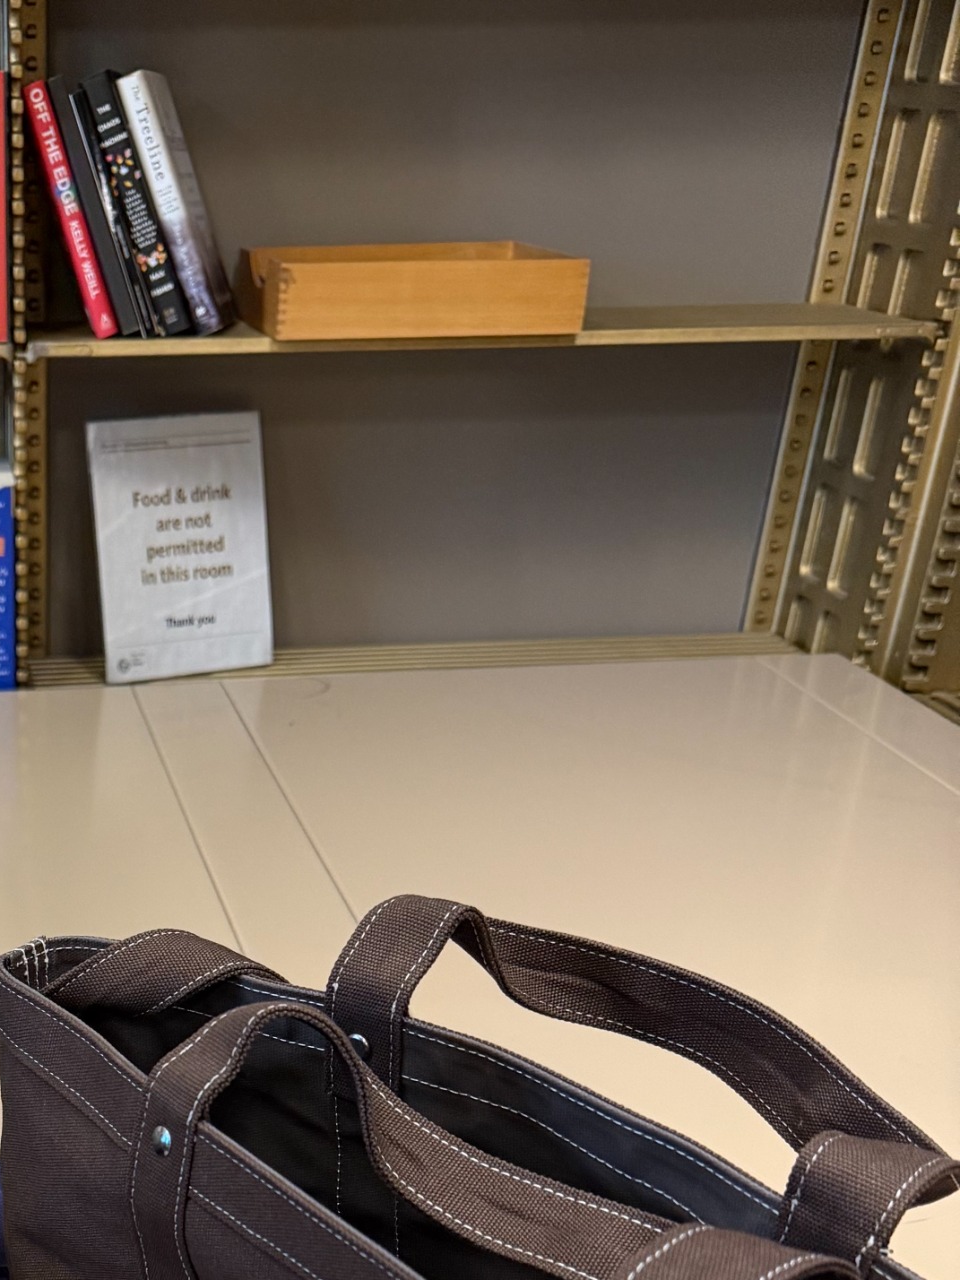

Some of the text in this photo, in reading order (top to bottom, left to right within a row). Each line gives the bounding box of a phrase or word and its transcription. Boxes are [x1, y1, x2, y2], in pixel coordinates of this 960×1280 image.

[130, 84, 142, 102] The
[96, 103, 112, 116] THE
[29, 86, 80, 217] OFF THE EDGE
[135, 102, 166, 183] Treeline
[69, 220, 101, 301] KELLY WEILL
[131, 483, 233, 508] Food & drink
[155, 512, 213, 532] are not
[146, 536, 226, 563] permitted
[141, 564, 234, 586] in this room
[166, 614, 217, 629] Thank you
